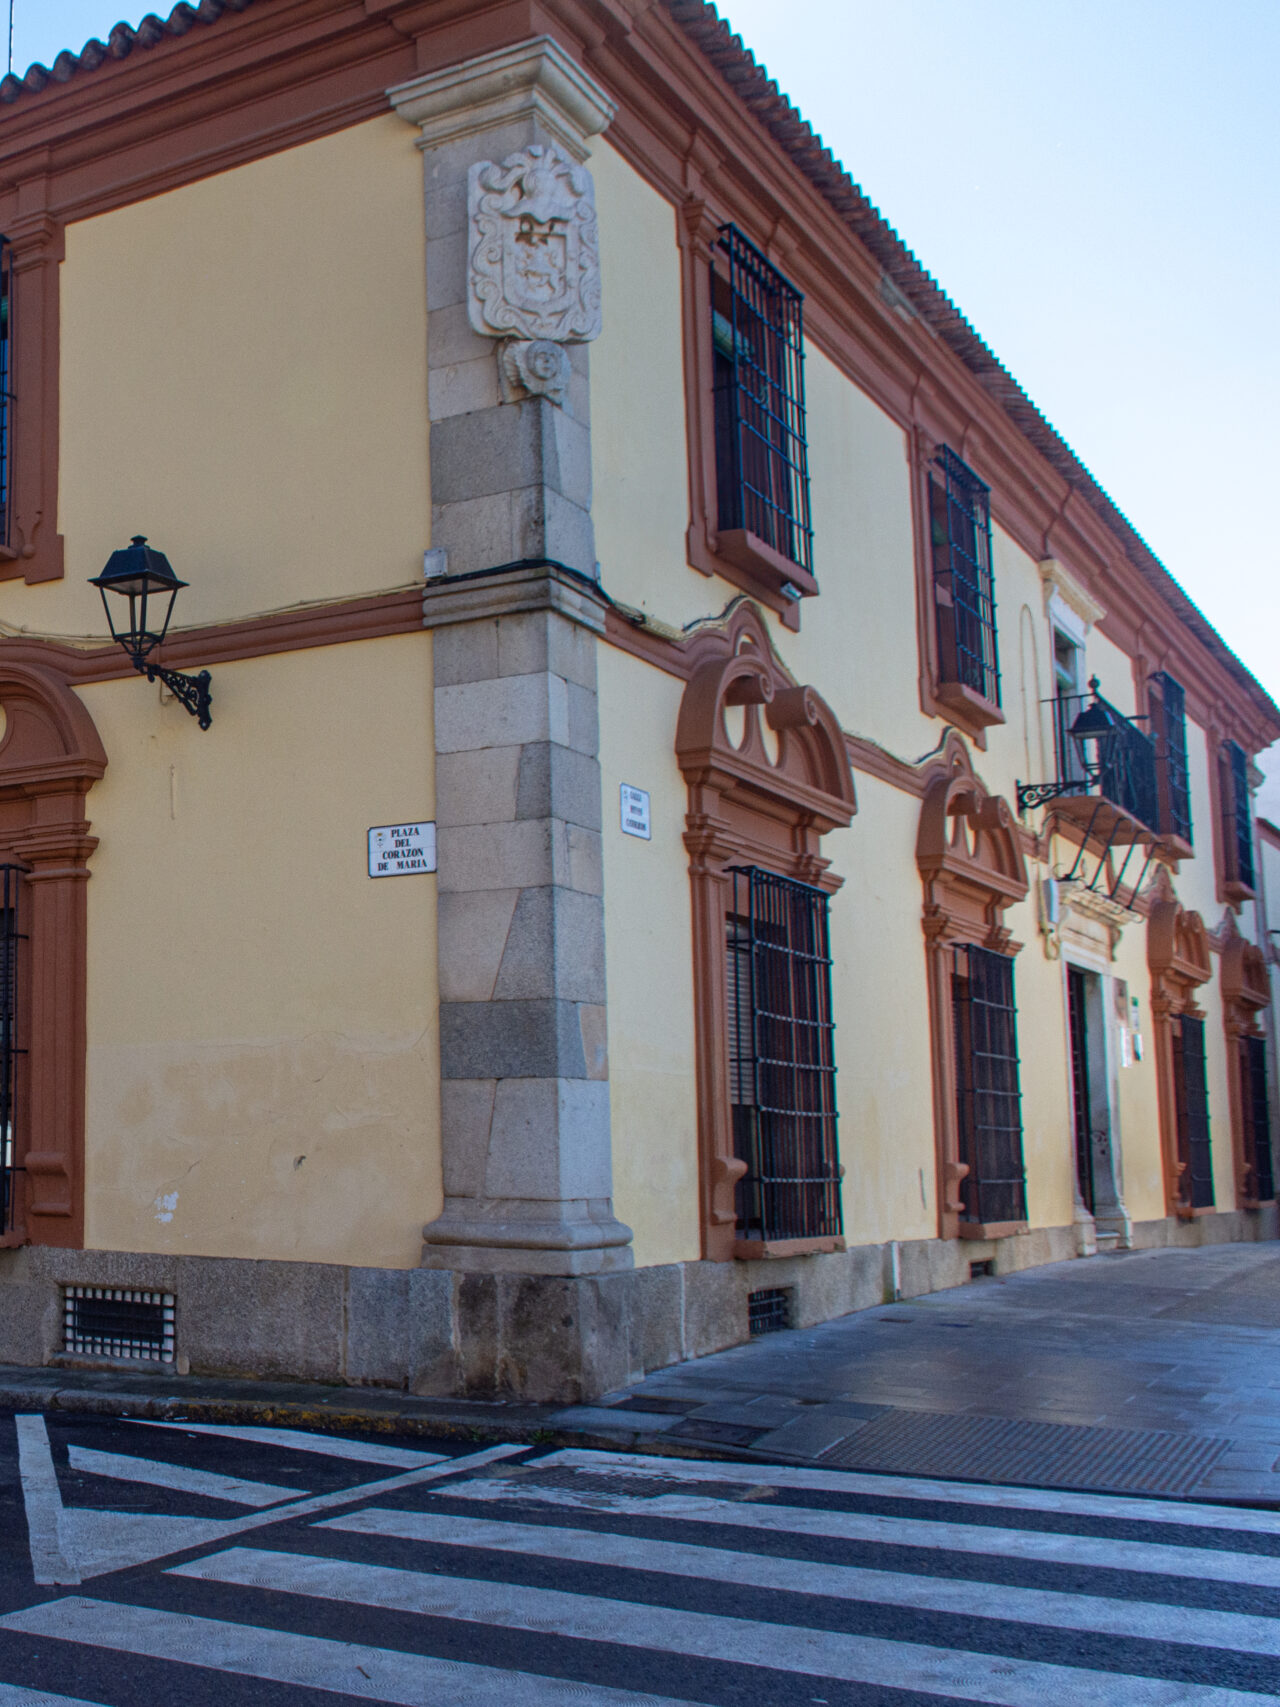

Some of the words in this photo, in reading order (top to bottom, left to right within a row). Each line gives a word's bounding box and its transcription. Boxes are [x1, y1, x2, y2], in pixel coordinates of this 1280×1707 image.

[391, 827, 420, 838] PLAZA
[394, 838, 411, 848] DEL
[382, 848, 424, 860] CORAZON
[377, 862, 389, 871] DE
[397, 859, 427, 869] MARIA
